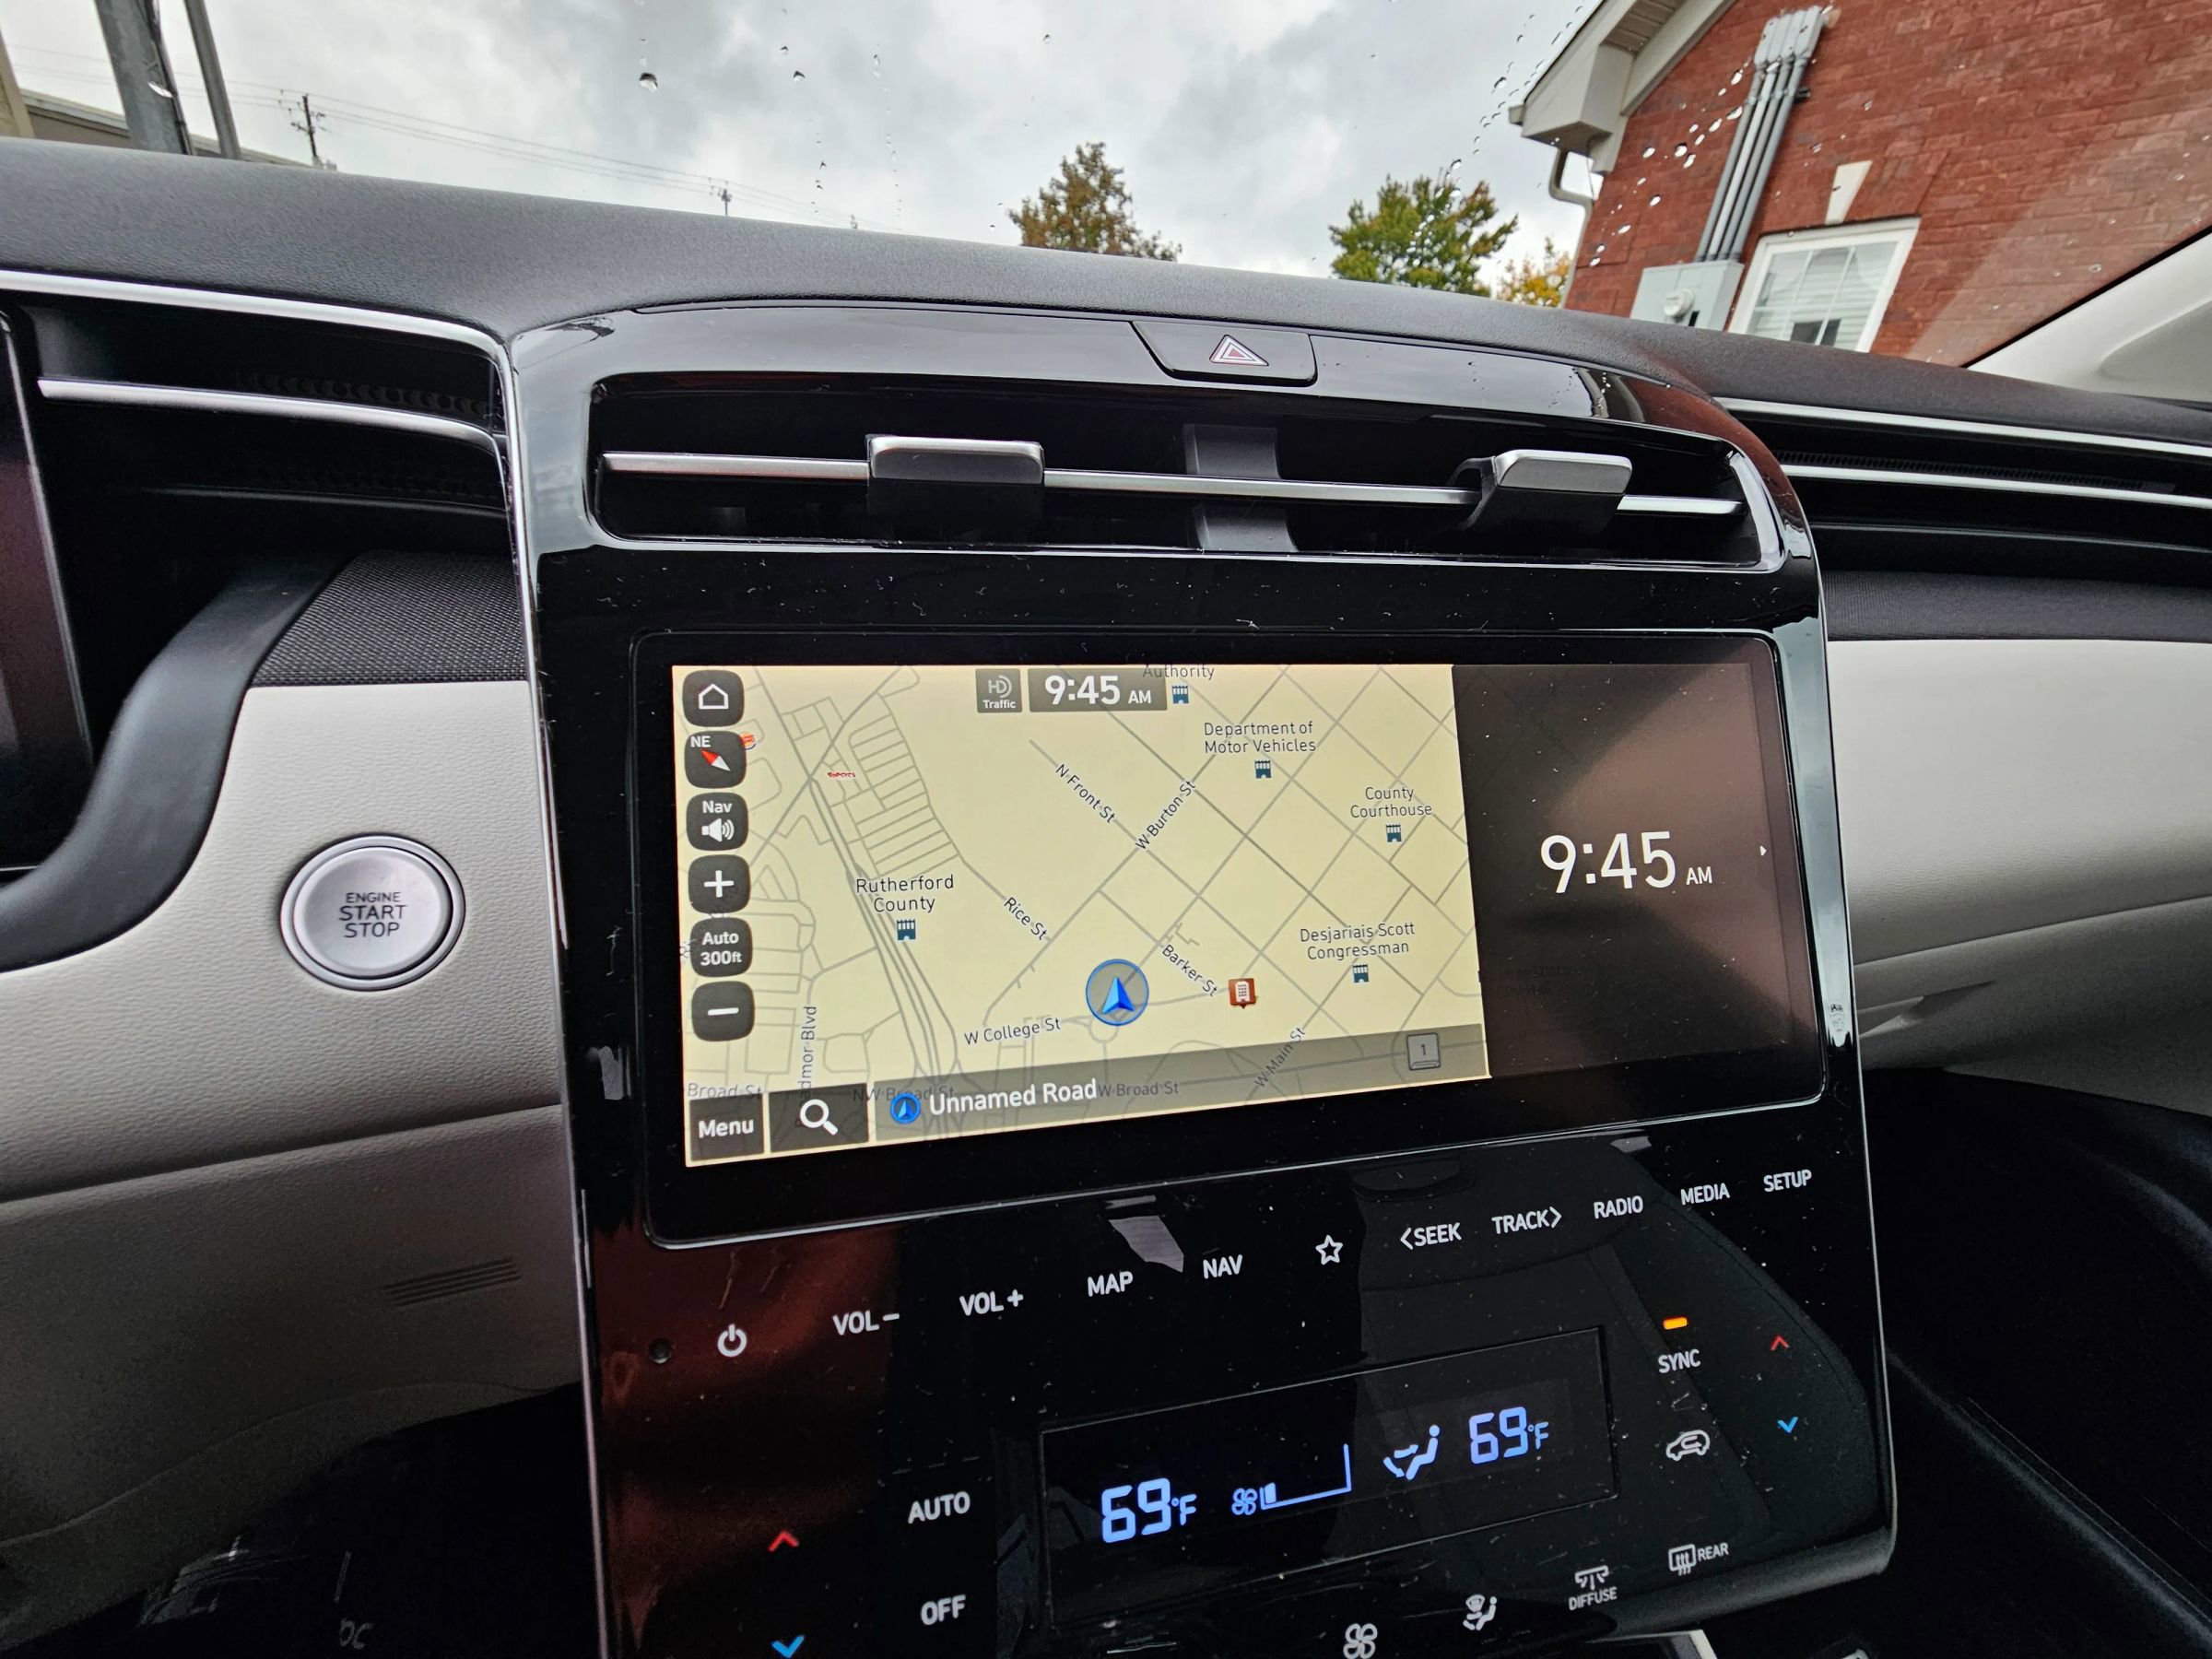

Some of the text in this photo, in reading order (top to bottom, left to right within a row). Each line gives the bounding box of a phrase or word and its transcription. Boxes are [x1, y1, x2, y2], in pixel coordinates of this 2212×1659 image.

[1142, 665, 1215, 680] Authority
[1044, 675, 1152, 705] 9:45 AM
[982, 700, 1017, 709] Traffic
[1204, 721, 1313, 738] Department of
[690, 735, 712, 747] NE
[1205, 739, 1316, 754] Motor Vehicles
[1055, 763, 1115, 824] N Front St
[1365, 786, 1414, 803] County
[702, 801, 733, 814] Nav
[1135, 780, 1196, 851] W Burton St
[1350, 804, 1432, 819] Courthouse
[1540, 830, 1712, 894] 9:45 AM
[855, 875, 954, 894] Rutherford
[346, 891, 402, 903] ENGINE
[874, 896, 935, 913] County
[339, 904, 407, 922] START
[1004, 896, 1048, 941] Rice St
[344, 922, 400, 938] STOP
[701, 931, 739, 946] Auto
[1378, 922, 1416, 937] Scott
[700, 950, 742, 966] 300ft
[1307, 942, 1409, 961] Congressman
[1161, 944, 1218, 996] Barker St
[800, 1006, 817, 1041] Blvd
[964, 1017, 1061, 1045] W College St
[1254, 1027, 1306, 1089] W Main St
[687, 1082, 738, 1098] Broad
[929, 1078, 1098, 1115] Unnamed Road
[1116, 1082, 1159, 1096] Broad
[1163, 1080, 1179, 1095] St
[699, 1118, 754, 1138] Menu
[1763, 1170, 1812, 1192] SETUP
[1680, 1182, 1730, 1206] MEDIA
[1594, 1195, 1643, 1219] RADIO
[1203, 1254, 1243, 1278] NAV
[1088, 1271, 1134, 1297] MAP
[1658, 1349, 1700, 1373] SYNC
[908, 1491, 971, 1524] AUTO
[1697, 1543, 1729, 1560] REAR
[1569, 1587, 1618, 1610] DIFFUSE
[921, 1594, 966, 1625] OFF
